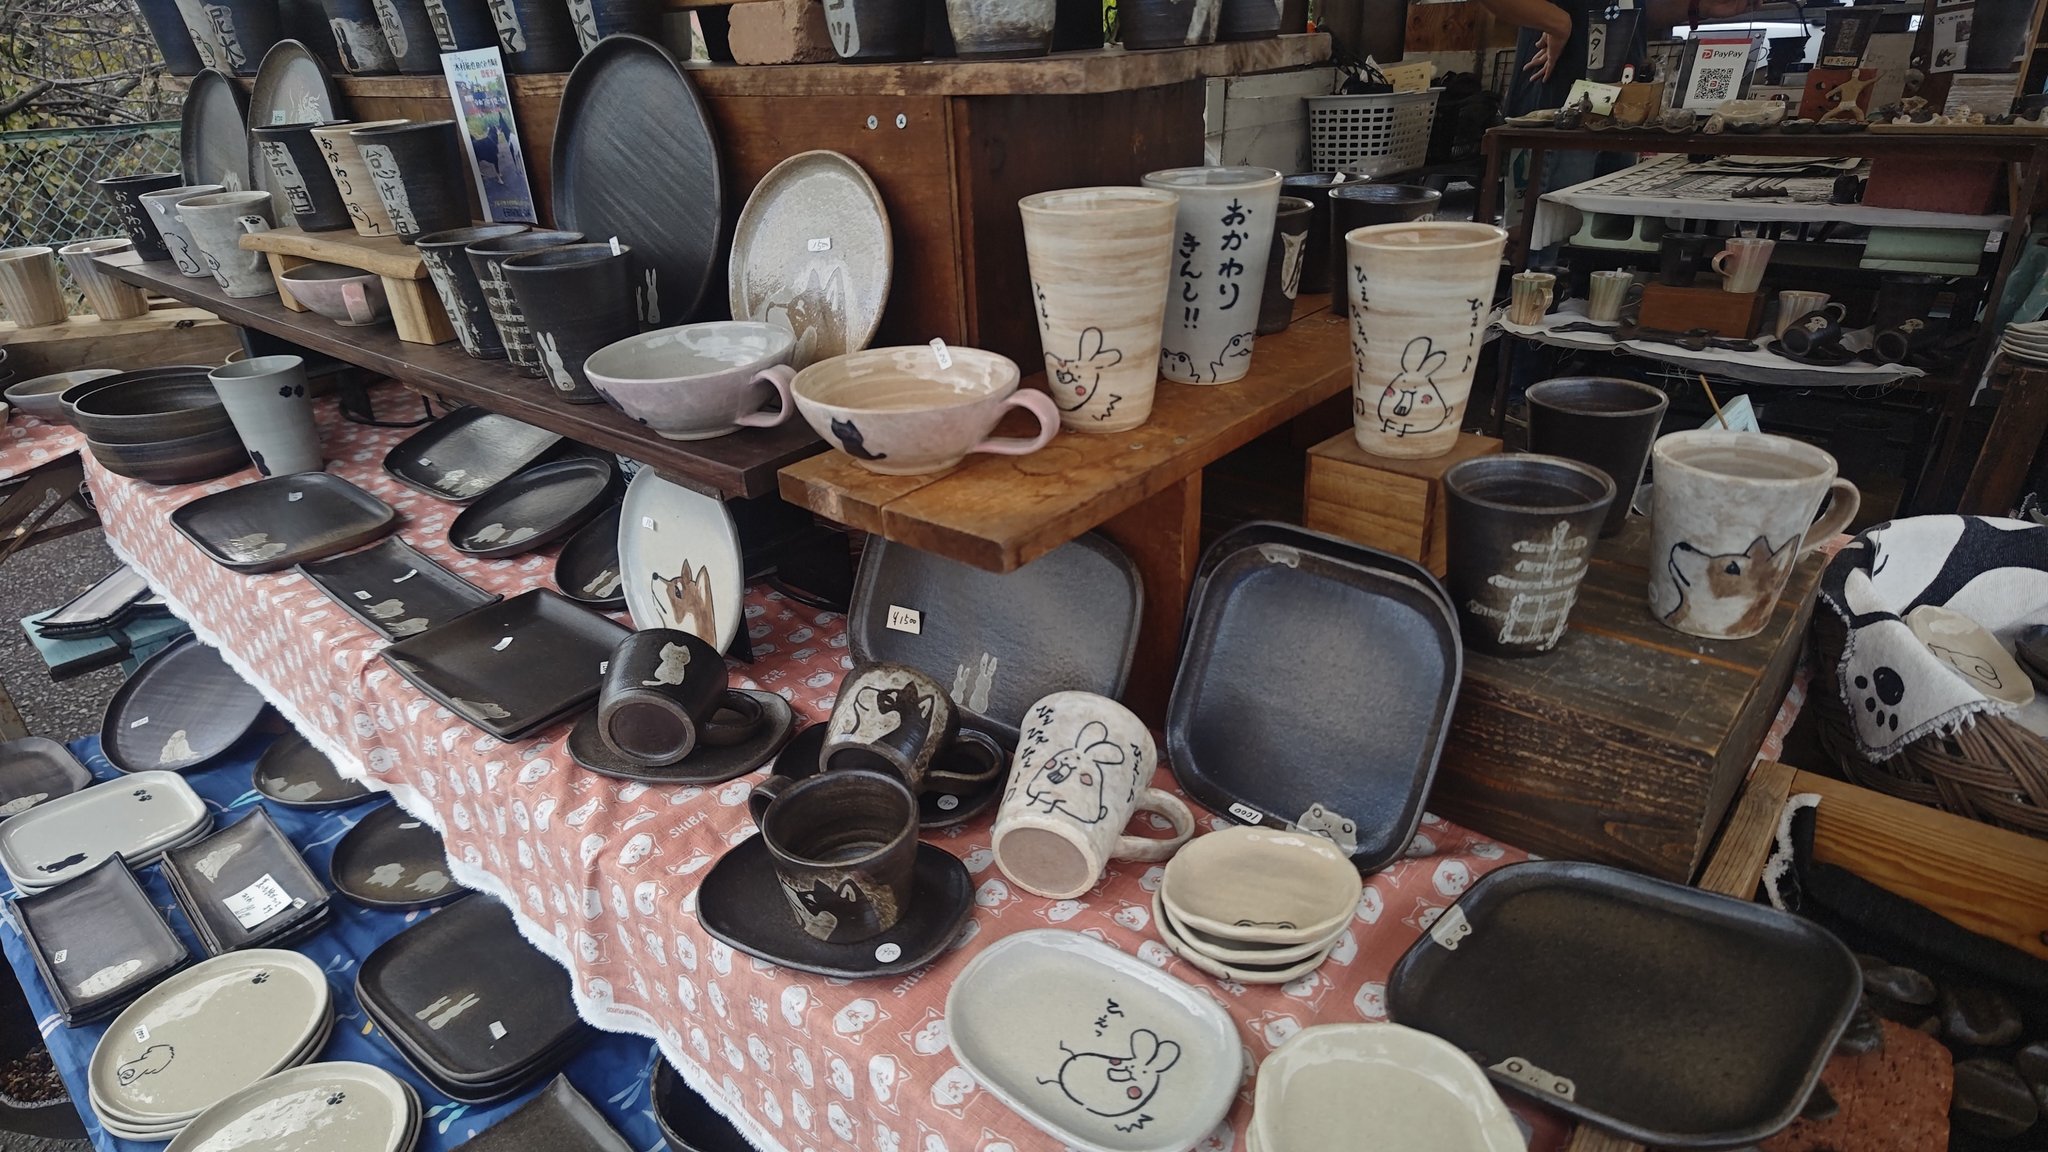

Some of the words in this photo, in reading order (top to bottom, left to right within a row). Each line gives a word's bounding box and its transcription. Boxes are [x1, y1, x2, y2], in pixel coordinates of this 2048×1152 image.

[567, 0, 599, 51] 水
[1590, 27, 1604, 66] ヘタレ
[1713, 50, 1743, 59] PayPay
[320, 137, 353, 196] おかわり
[114, 190, 147, 242] おかわり
[1219, 198, 1252, 310] おかわり
[1179, 232, 1202, 329] きんし!!
[892, 611, 917, 626] ¥1500
[668, 810, 708, 839] SHIBA
[1234, 808, 1259, 821] 1000
